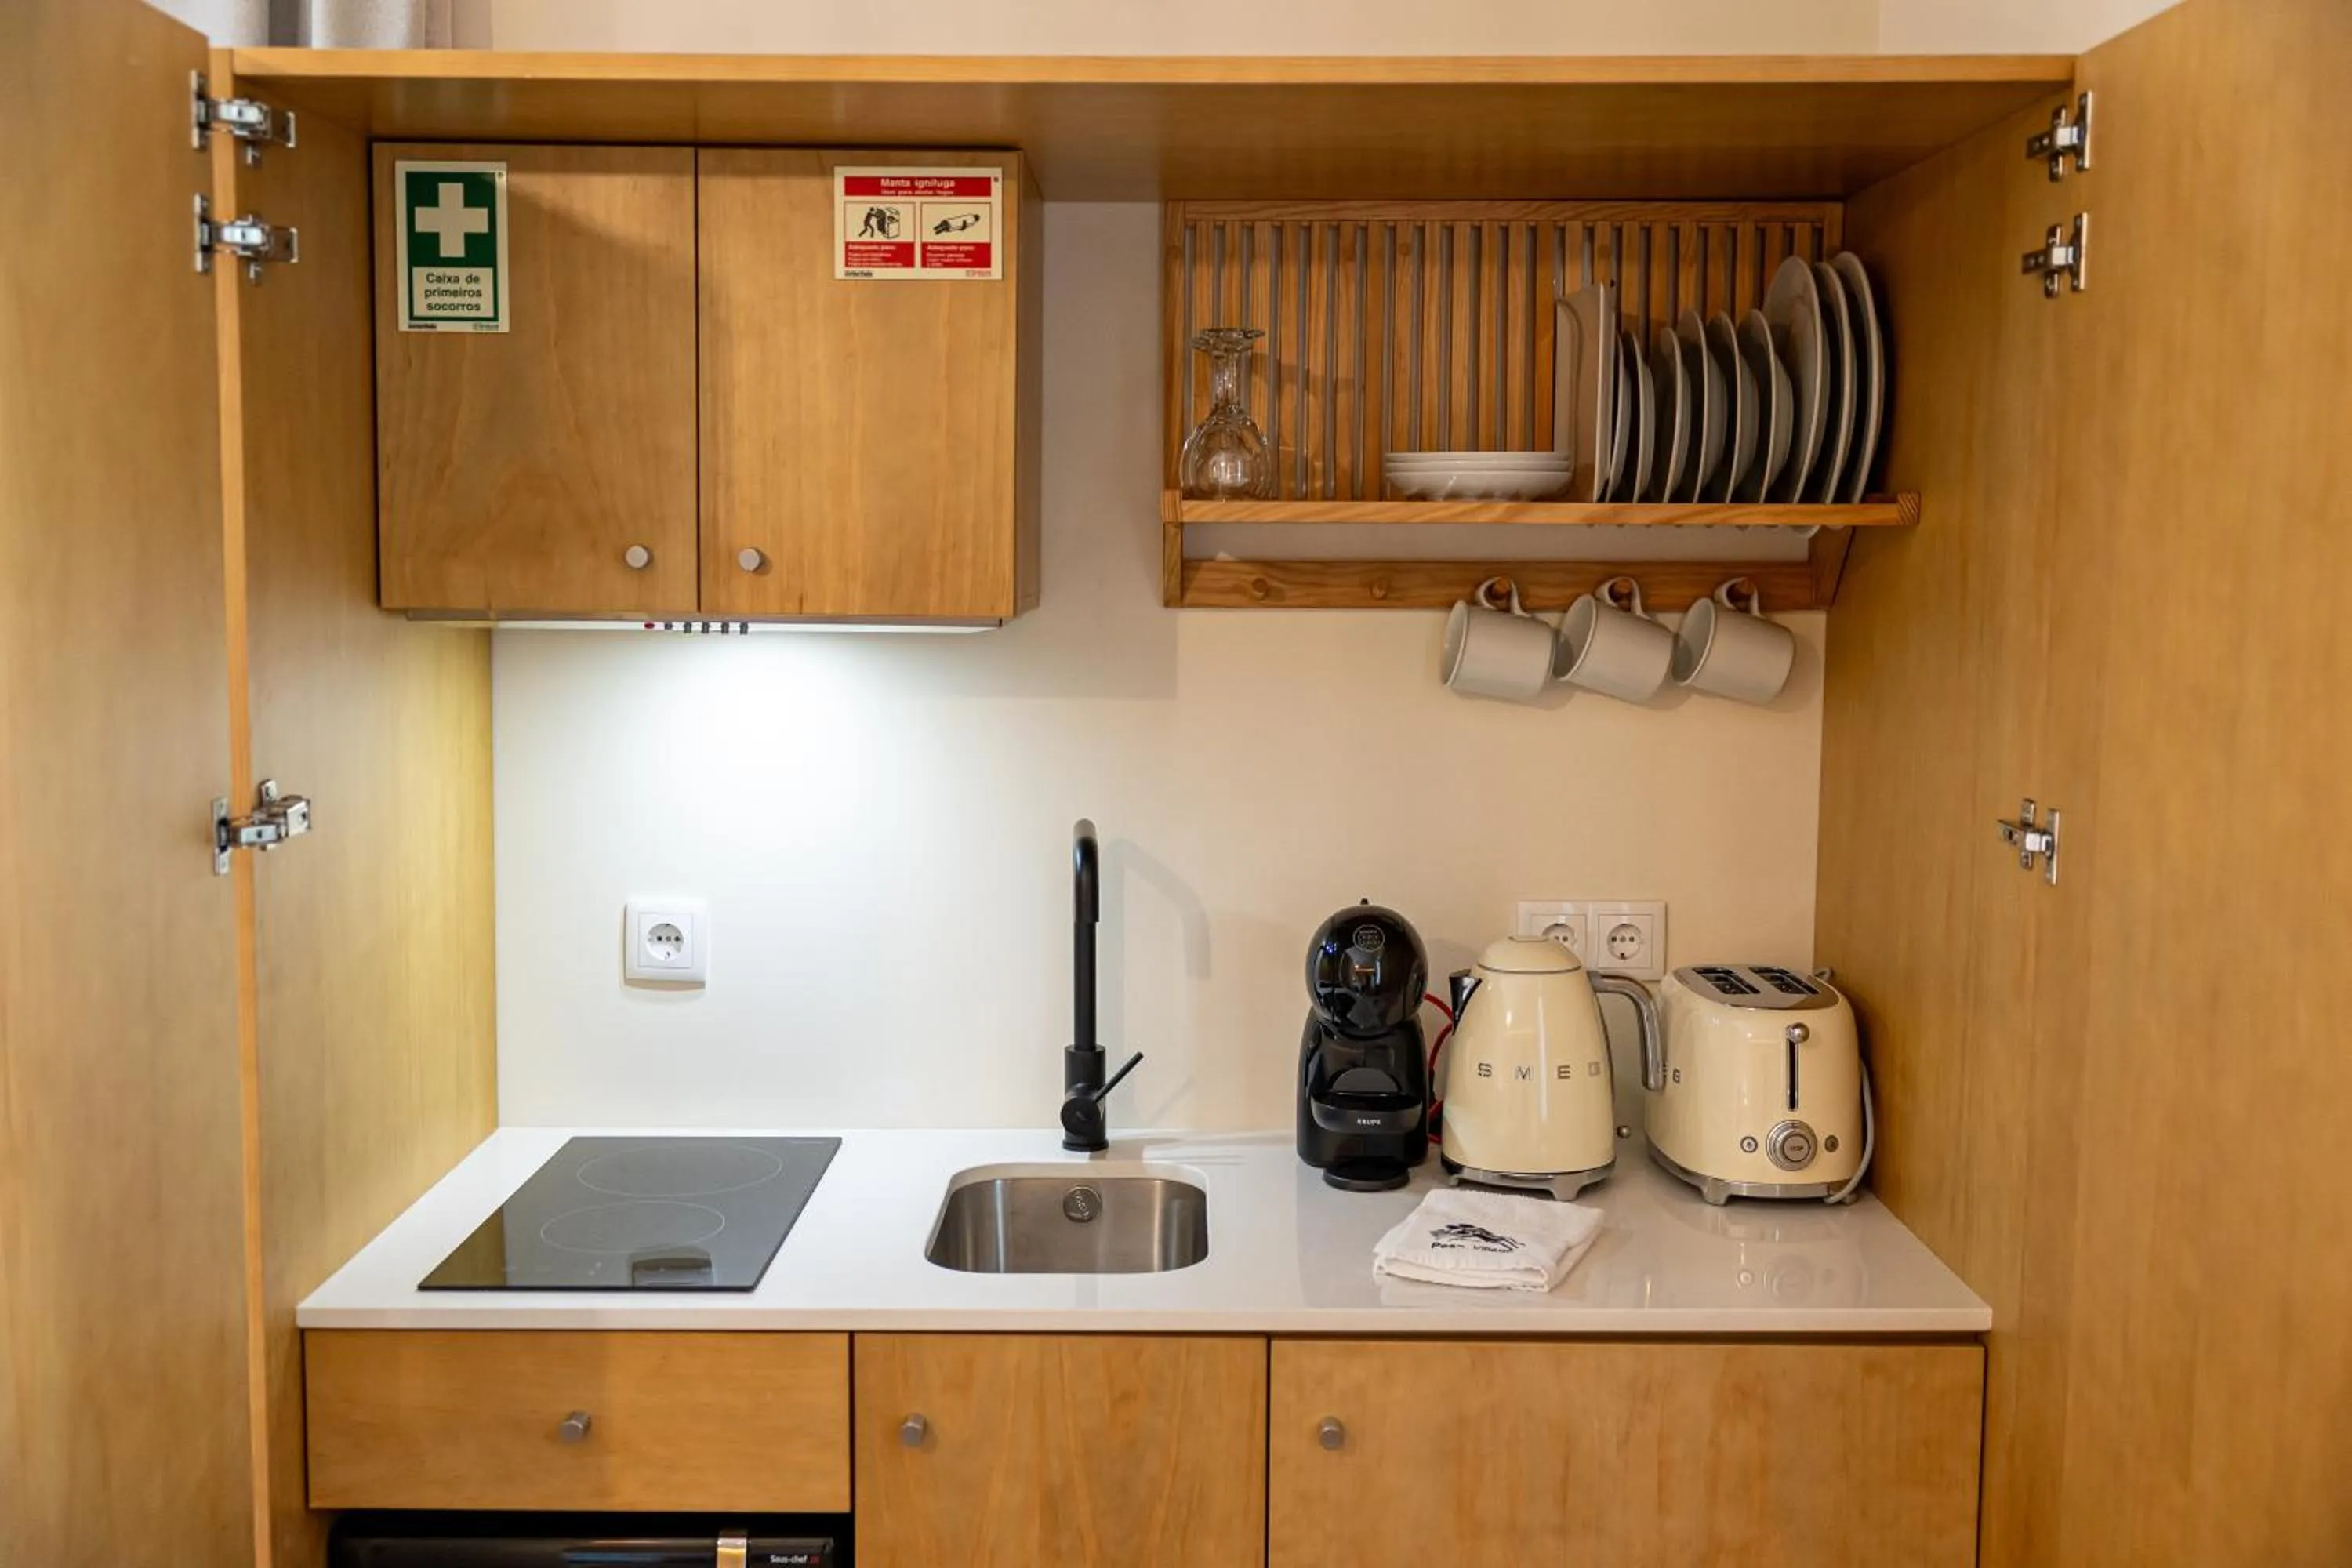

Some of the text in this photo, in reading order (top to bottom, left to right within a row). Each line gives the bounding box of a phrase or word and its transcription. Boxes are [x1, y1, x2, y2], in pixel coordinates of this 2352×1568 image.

[880, 178, 911, 187] Manta
[426, 273, 481, 284] Caixa de
[424, 287, 482, 299] primeiros
[426, 302, 481, 311] socorros
